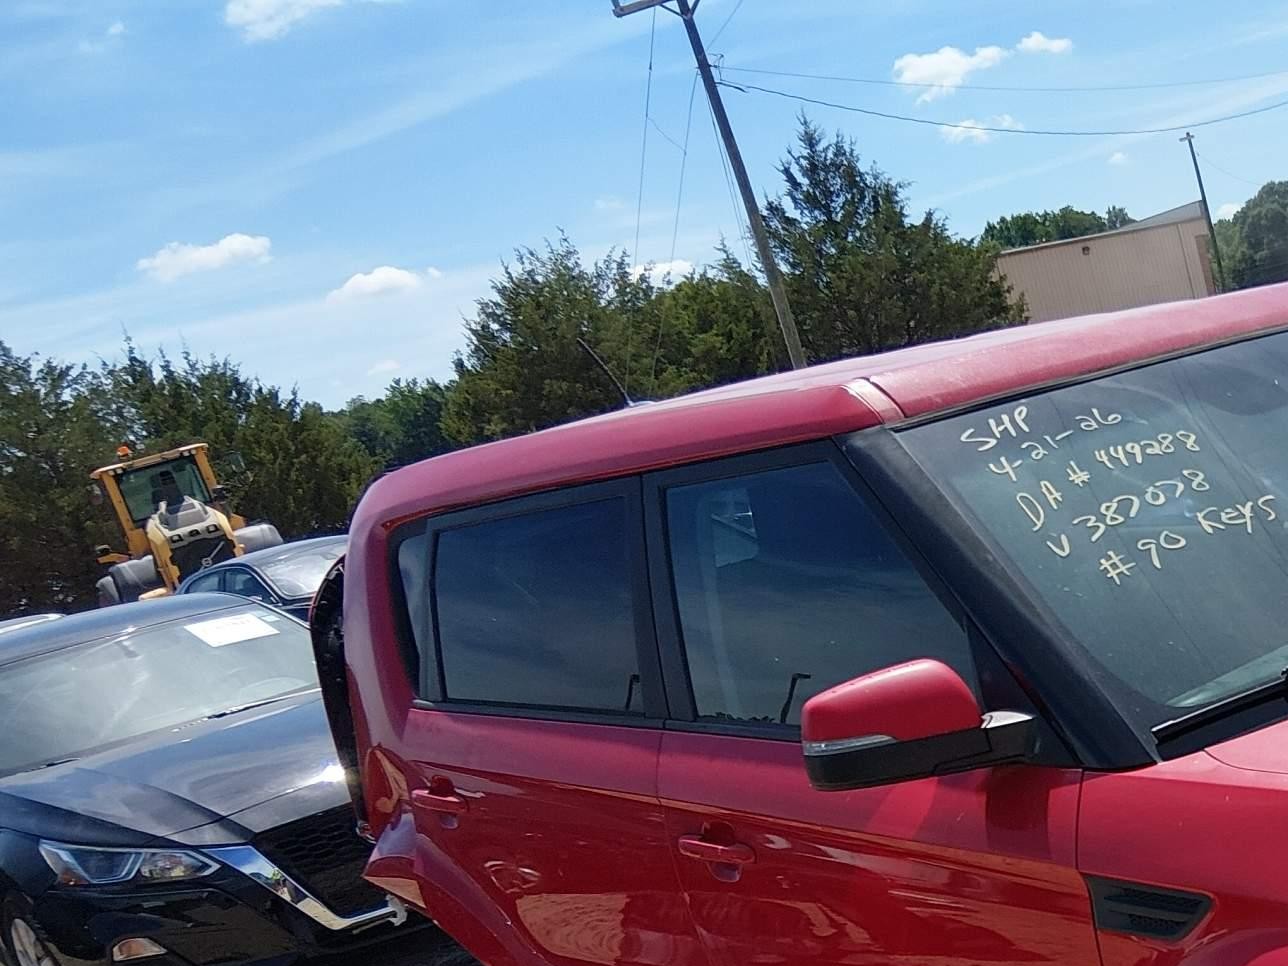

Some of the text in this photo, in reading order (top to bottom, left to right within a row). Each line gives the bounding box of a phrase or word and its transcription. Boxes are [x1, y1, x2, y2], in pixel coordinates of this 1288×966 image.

[960, 405, 1030, 452] SHP
[1016, 430, 1201, 531] DA # 449288
[1099, 550, 1137, 586] #
[1137, 529, 1187, 570] 90
